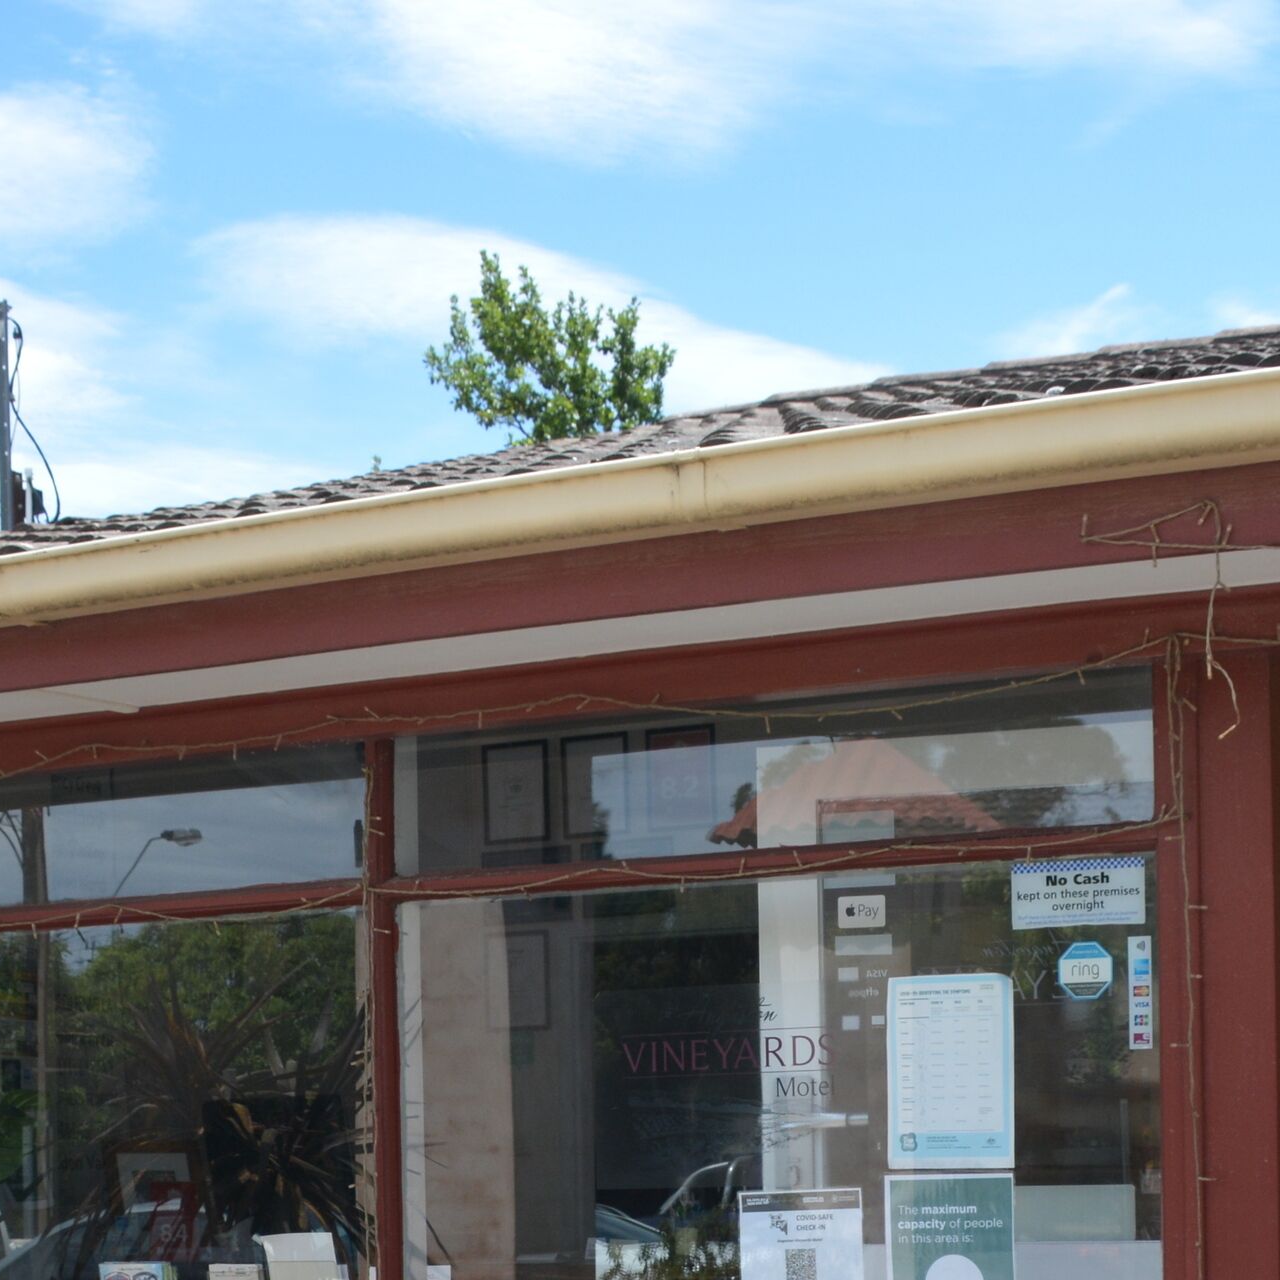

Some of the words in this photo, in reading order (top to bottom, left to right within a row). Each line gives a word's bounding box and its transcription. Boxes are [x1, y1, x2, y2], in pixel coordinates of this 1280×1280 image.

[1045, 875, 1068, 887] No
[1073, 871, 1110, 885] Cash
[1016, 891, 1041, 903] kept
[1043, 890, 1057, 900] on
[1060, 888, 1090, 899] these
[1092, 886, 1140, 901] premises
[857, 903, 880, 919] Pay
[1051, 900, 1105, 912] overnight
[1071, 961, 1100, 979] ring
[622, 1033, 838, 1073] VINEYARDS
[775, 1076, 835, 1097] Motel
[898, 1205, 919, 1215] The
[921, 1204, 977, 1214] maximum
[898, 1219, 946, 1231] capacity
[949, 1218, 961, 1229] of
[964, 1217, 1003, 1230] people
[898, 1233, 909, 1243] in
[911, 1233, 932, 1243] this
[934, 1235, 959, 1243] area
[961, 1233, 974, 1243] is:
